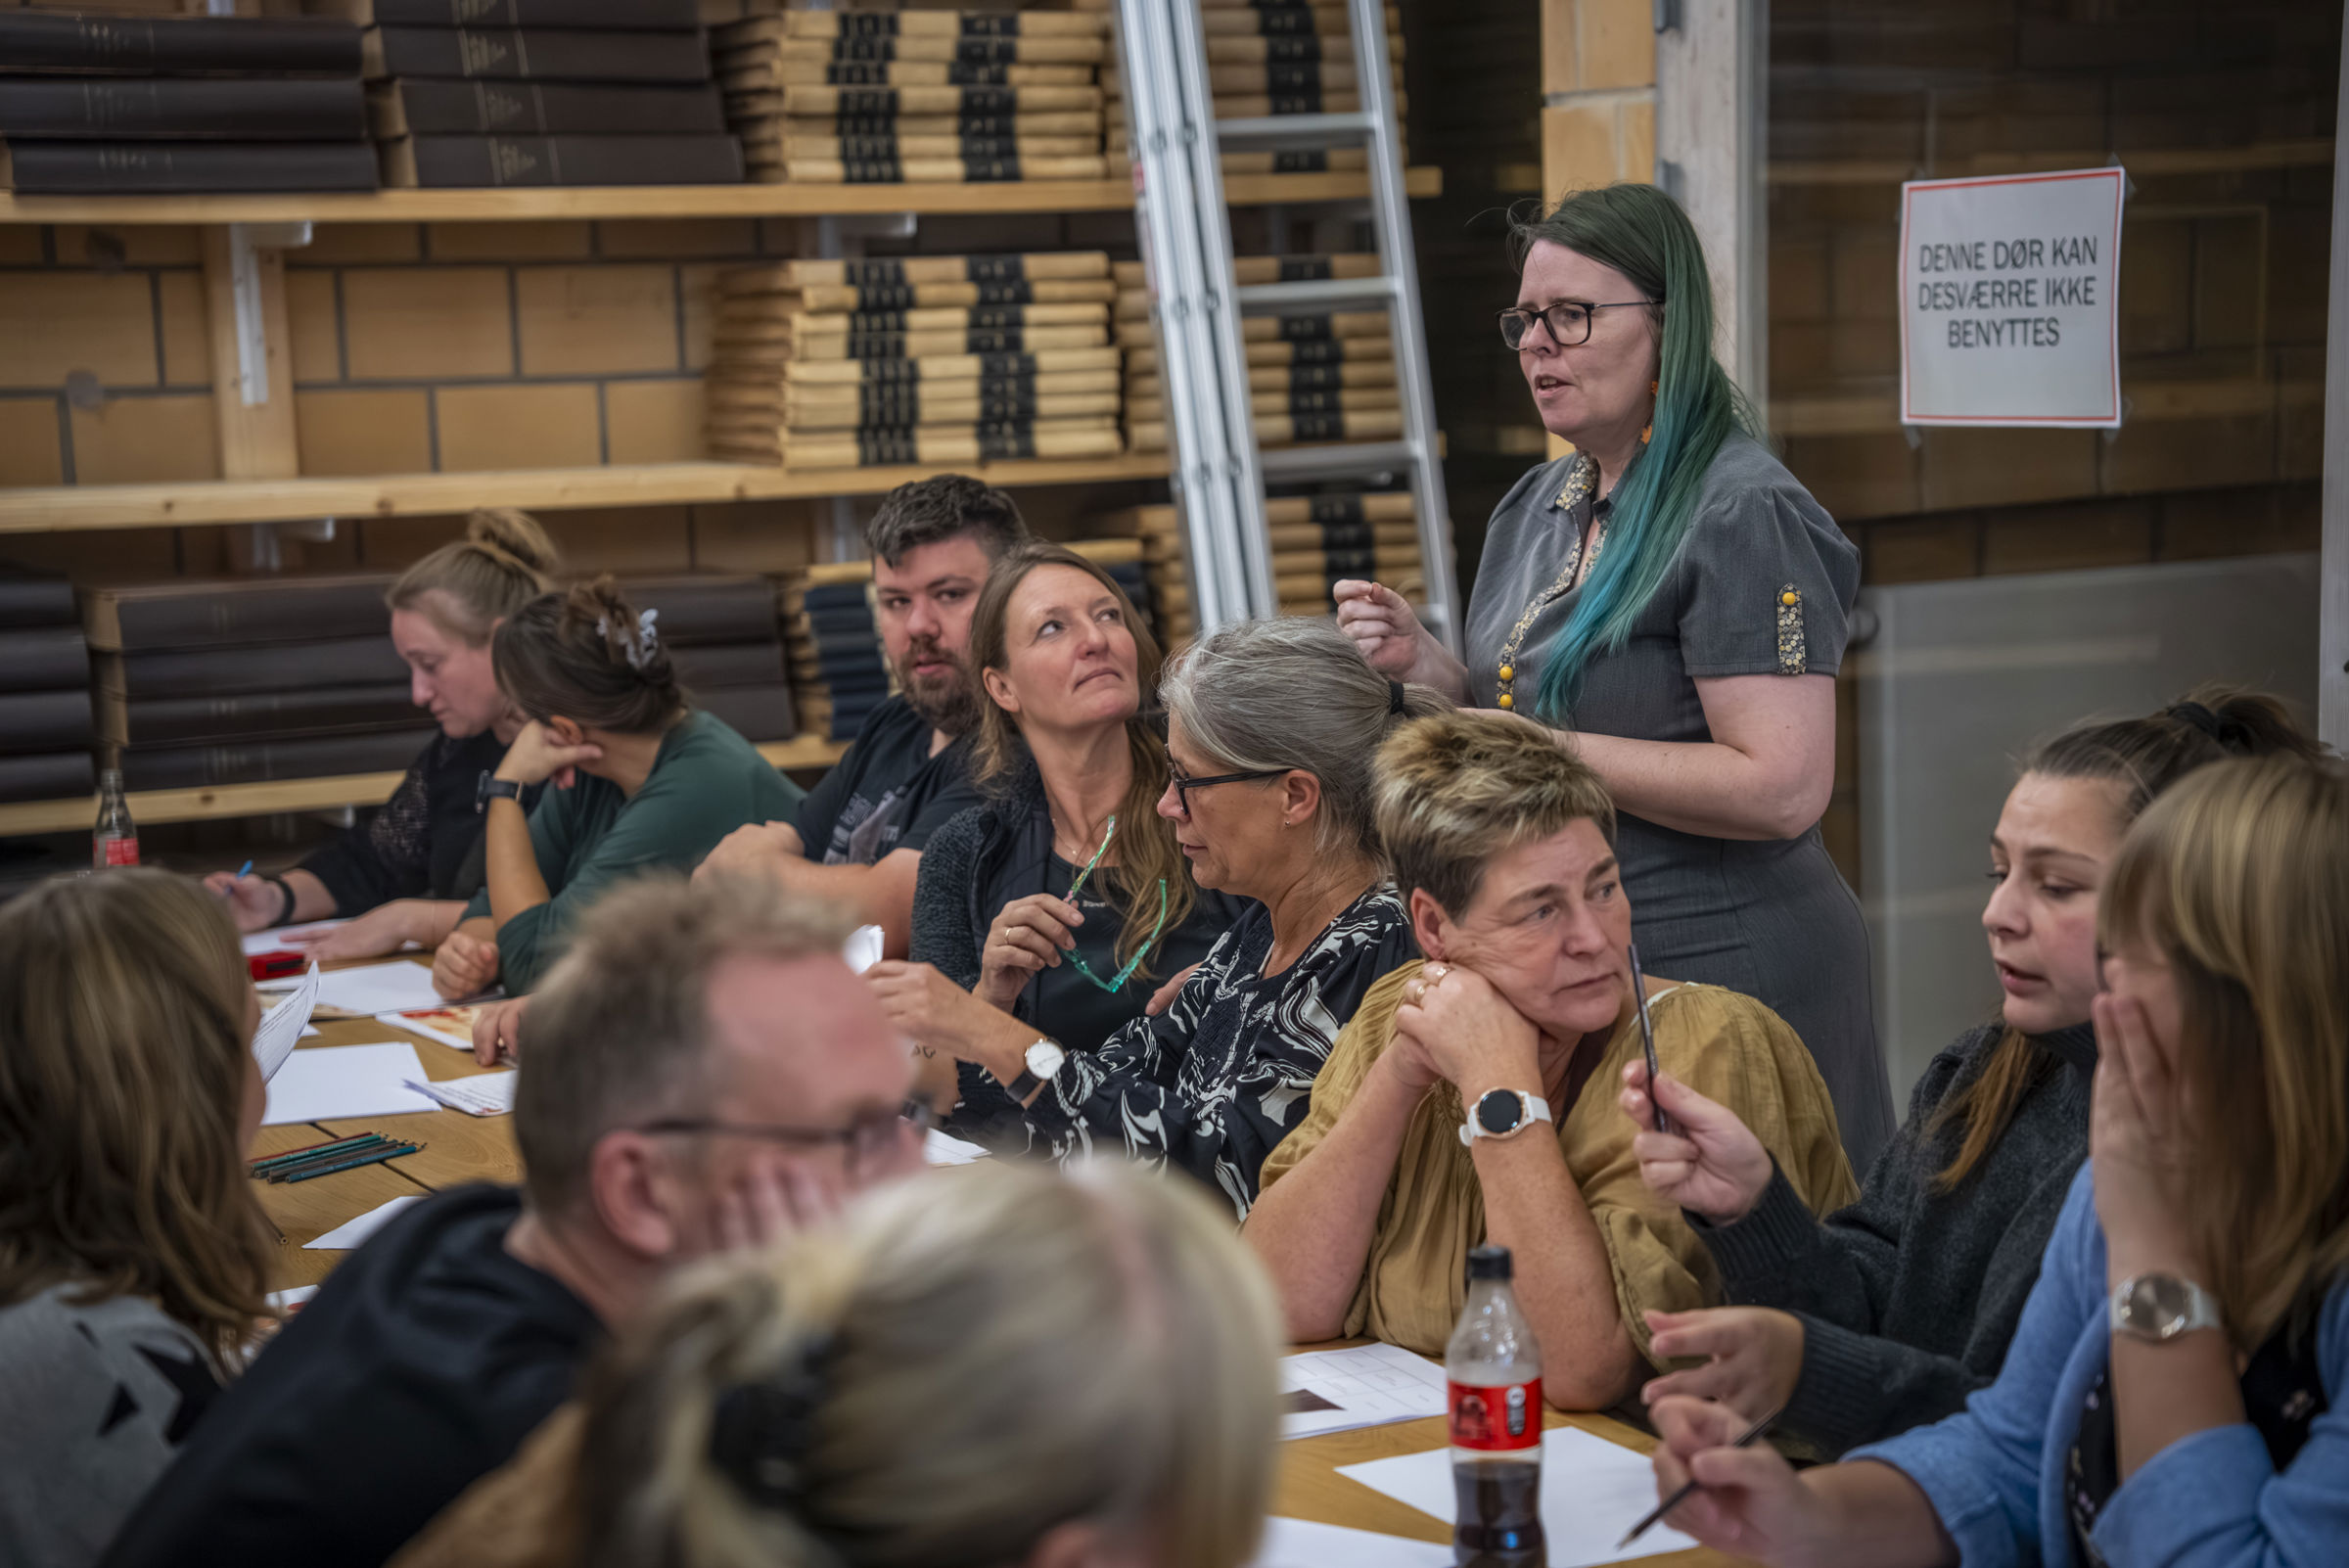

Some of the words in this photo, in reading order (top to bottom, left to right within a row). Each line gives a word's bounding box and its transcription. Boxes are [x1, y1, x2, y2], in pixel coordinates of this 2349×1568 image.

[1919, 242, 1987, 273] DENNE
[1993, 239, 2044, 269] DØR
[2051, 236, 2097, 266] KAN
[1918, 279, 2038, 311] DESVÆRRE
[2045, 276, 2096, 306] IKKE
[1948, 317, 2060, 348] BENYTTES
